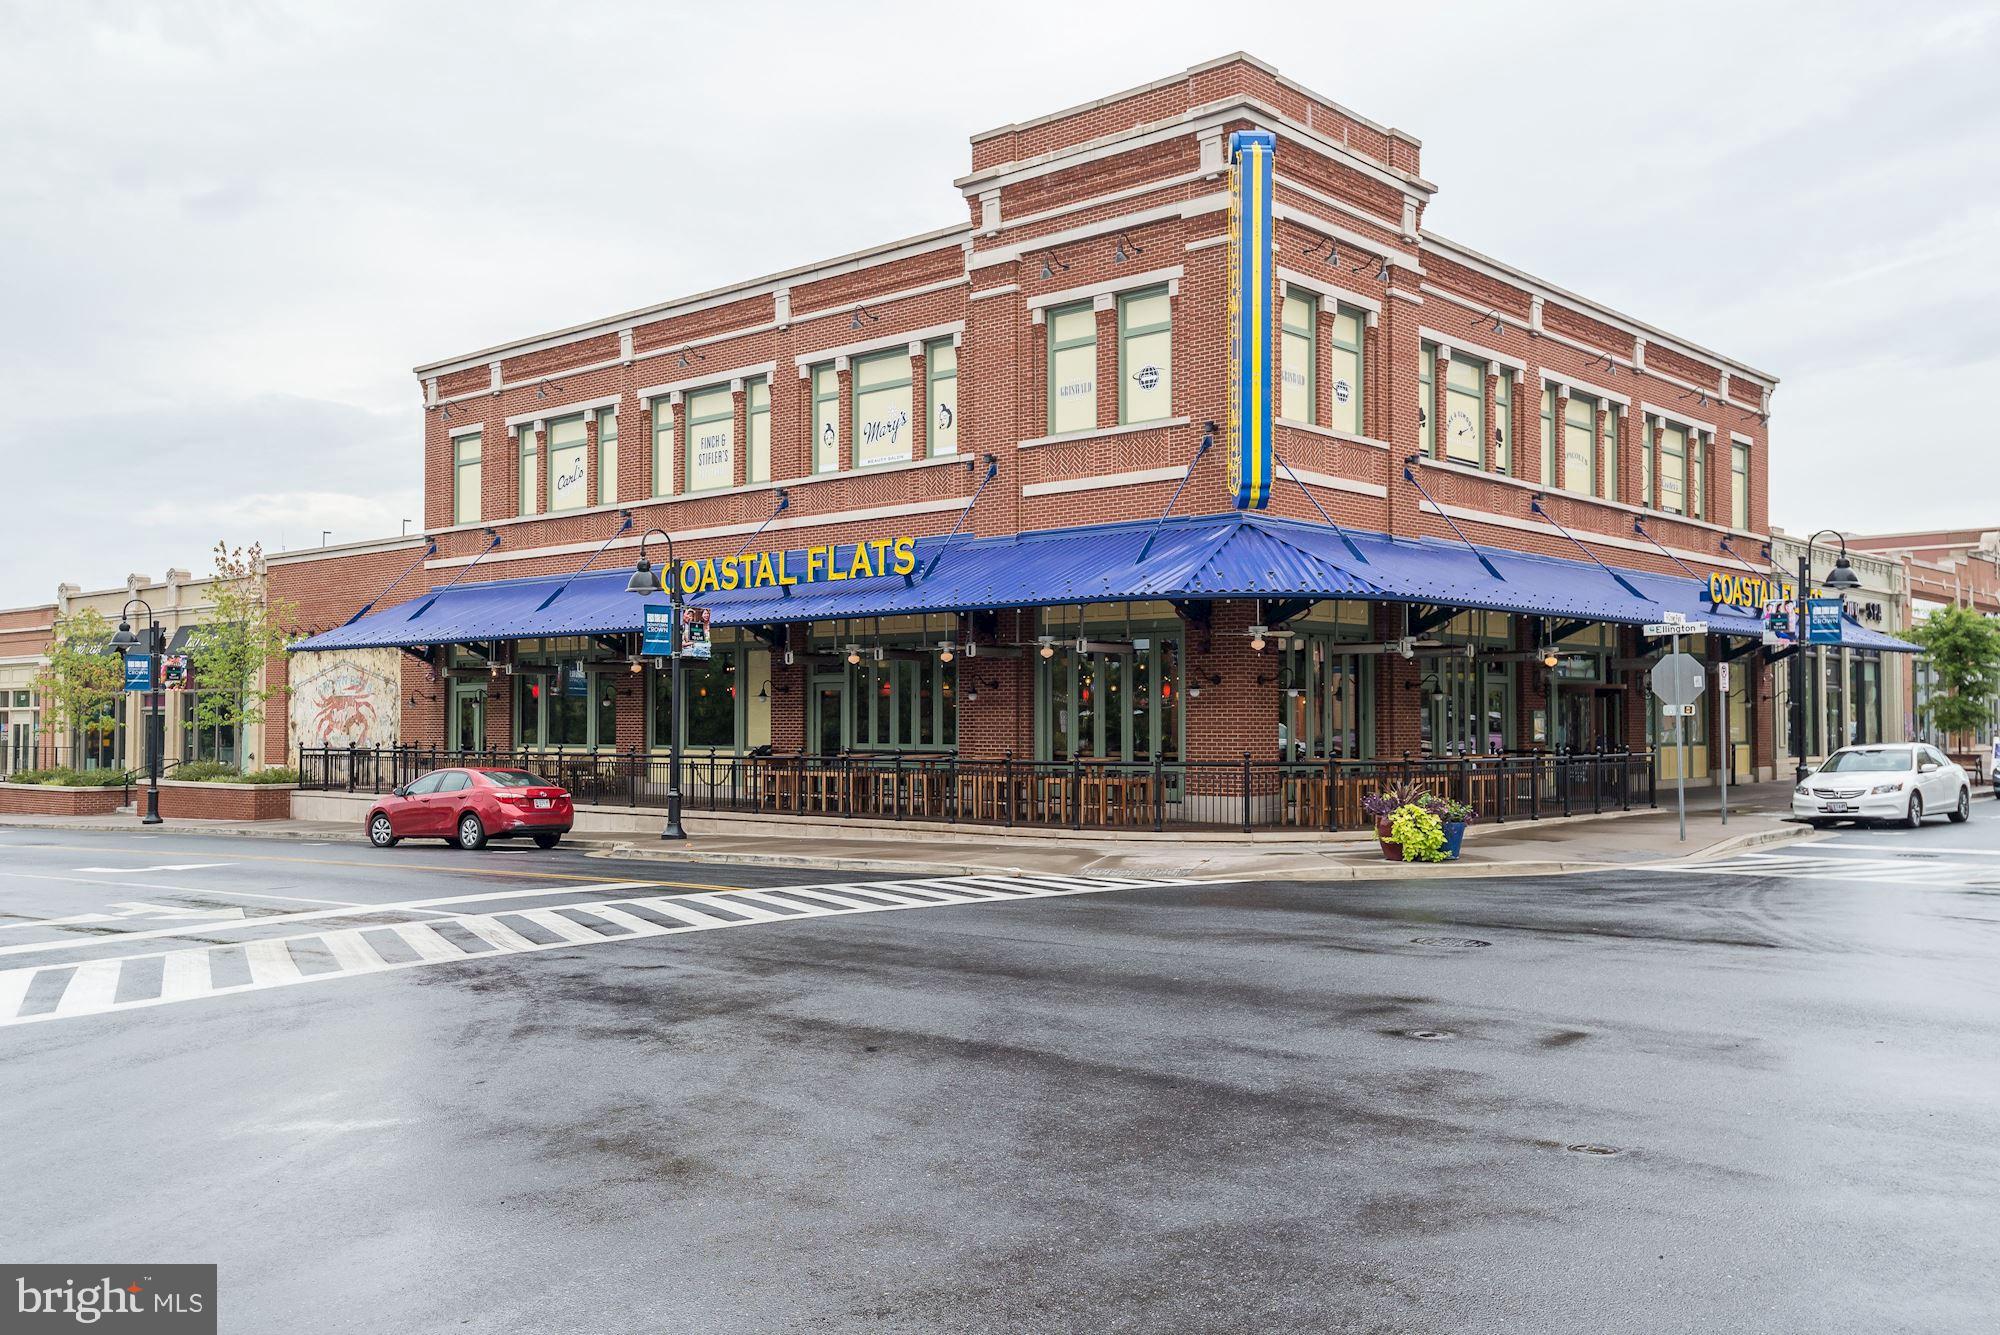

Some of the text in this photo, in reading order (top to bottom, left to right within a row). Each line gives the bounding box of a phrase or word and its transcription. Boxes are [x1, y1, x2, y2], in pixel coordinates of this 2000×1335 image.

[1060, 381, 1092, 397] GRISWALD
[863, 411, 908, 445] Mary's
[700, 435, 720, 450] FINCH
[698, 449, 729, 467] STIFLER'S
[557, 457, 584, 491] Carl's
[660, 536, 916, 595] COASTAL FLATS
[1710, 571, 1776, 609] COASTAL
[1655, 624, 1696, 634] Ellington
